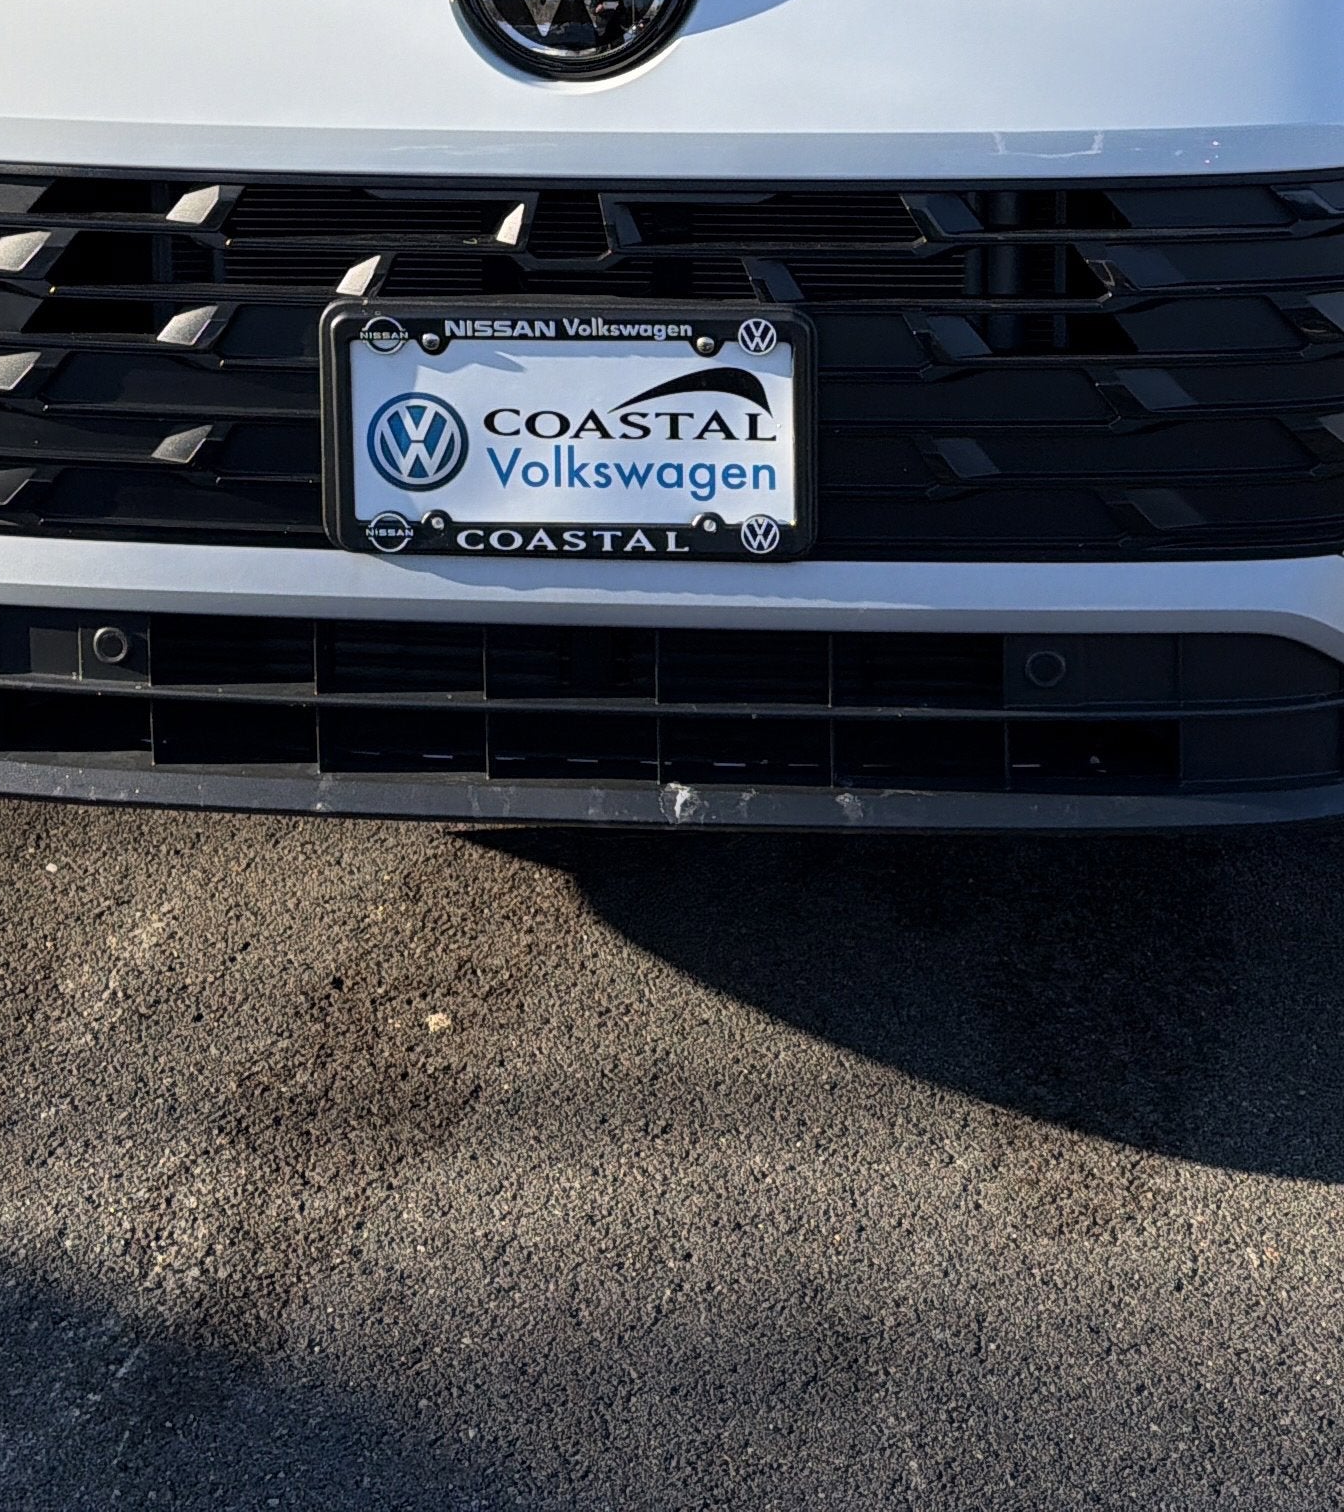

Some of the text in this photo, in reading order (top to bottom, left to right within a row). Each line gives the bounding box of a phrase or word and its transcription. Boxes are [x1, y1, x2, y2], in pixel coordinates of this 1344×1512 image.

[444, 317, 693, 342] NISSAN Volkswagen
[483, 408, 777, 442] COASTAL
[486, 444, 777, 502] Volkswagen
[456, 527, 690, 553] COASTAL
